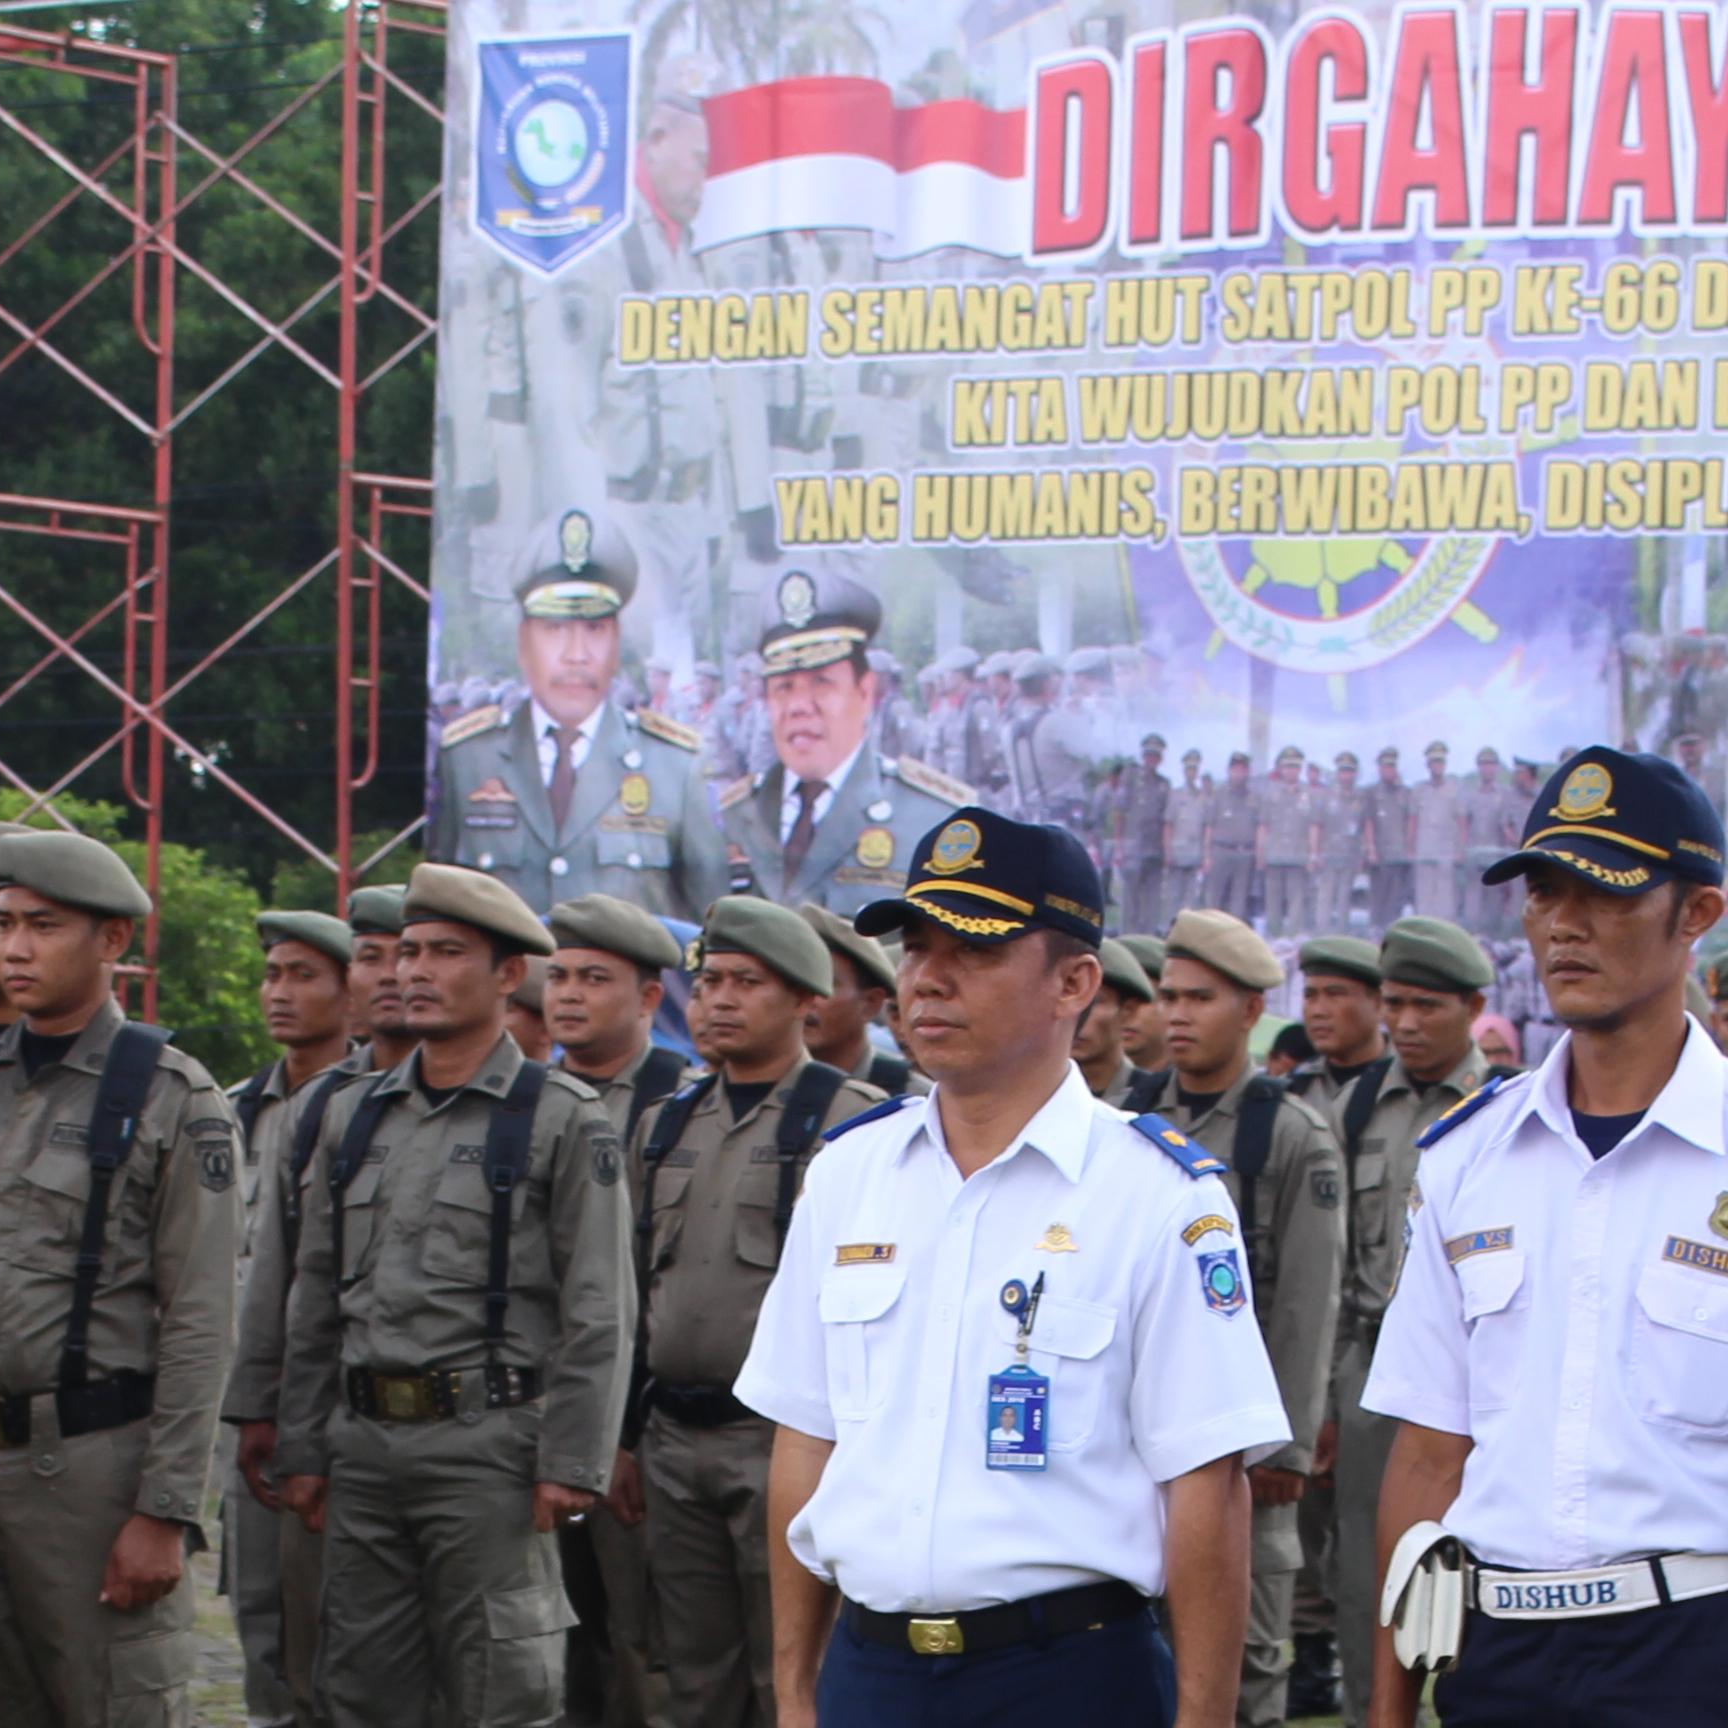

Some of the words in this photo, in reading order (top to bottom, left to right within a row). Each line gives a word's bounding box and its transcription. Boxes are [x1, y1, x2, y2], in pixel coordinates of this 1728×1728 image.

[621, 294, 807, 361] DENGAN
[821, 282, 1093, 355] SEMANGAT
[1106, 277, 1207, 344] HUT
[1224, 271, 1414, 340] SATPOL
[1430, 269, 1500, 335] PP
[1515, 262, 1679, 332] KE-66
[955, 379, 1066, 444] KITA
[1080, 369, 1372, 440] WUJUDKAN
[1388, 366, 1484, 432] POL
[1501, 365, 1572, 433] PP
[1586, 361, 1697, 429] DAN
[778, 476, 898, 541] YANG
[914, 470, 1165, 544] HUMANIS,
[1179, 460, 1530, 536] BERWIBAWA,
[1494, 1580, 1617, 1610] DISHUB
